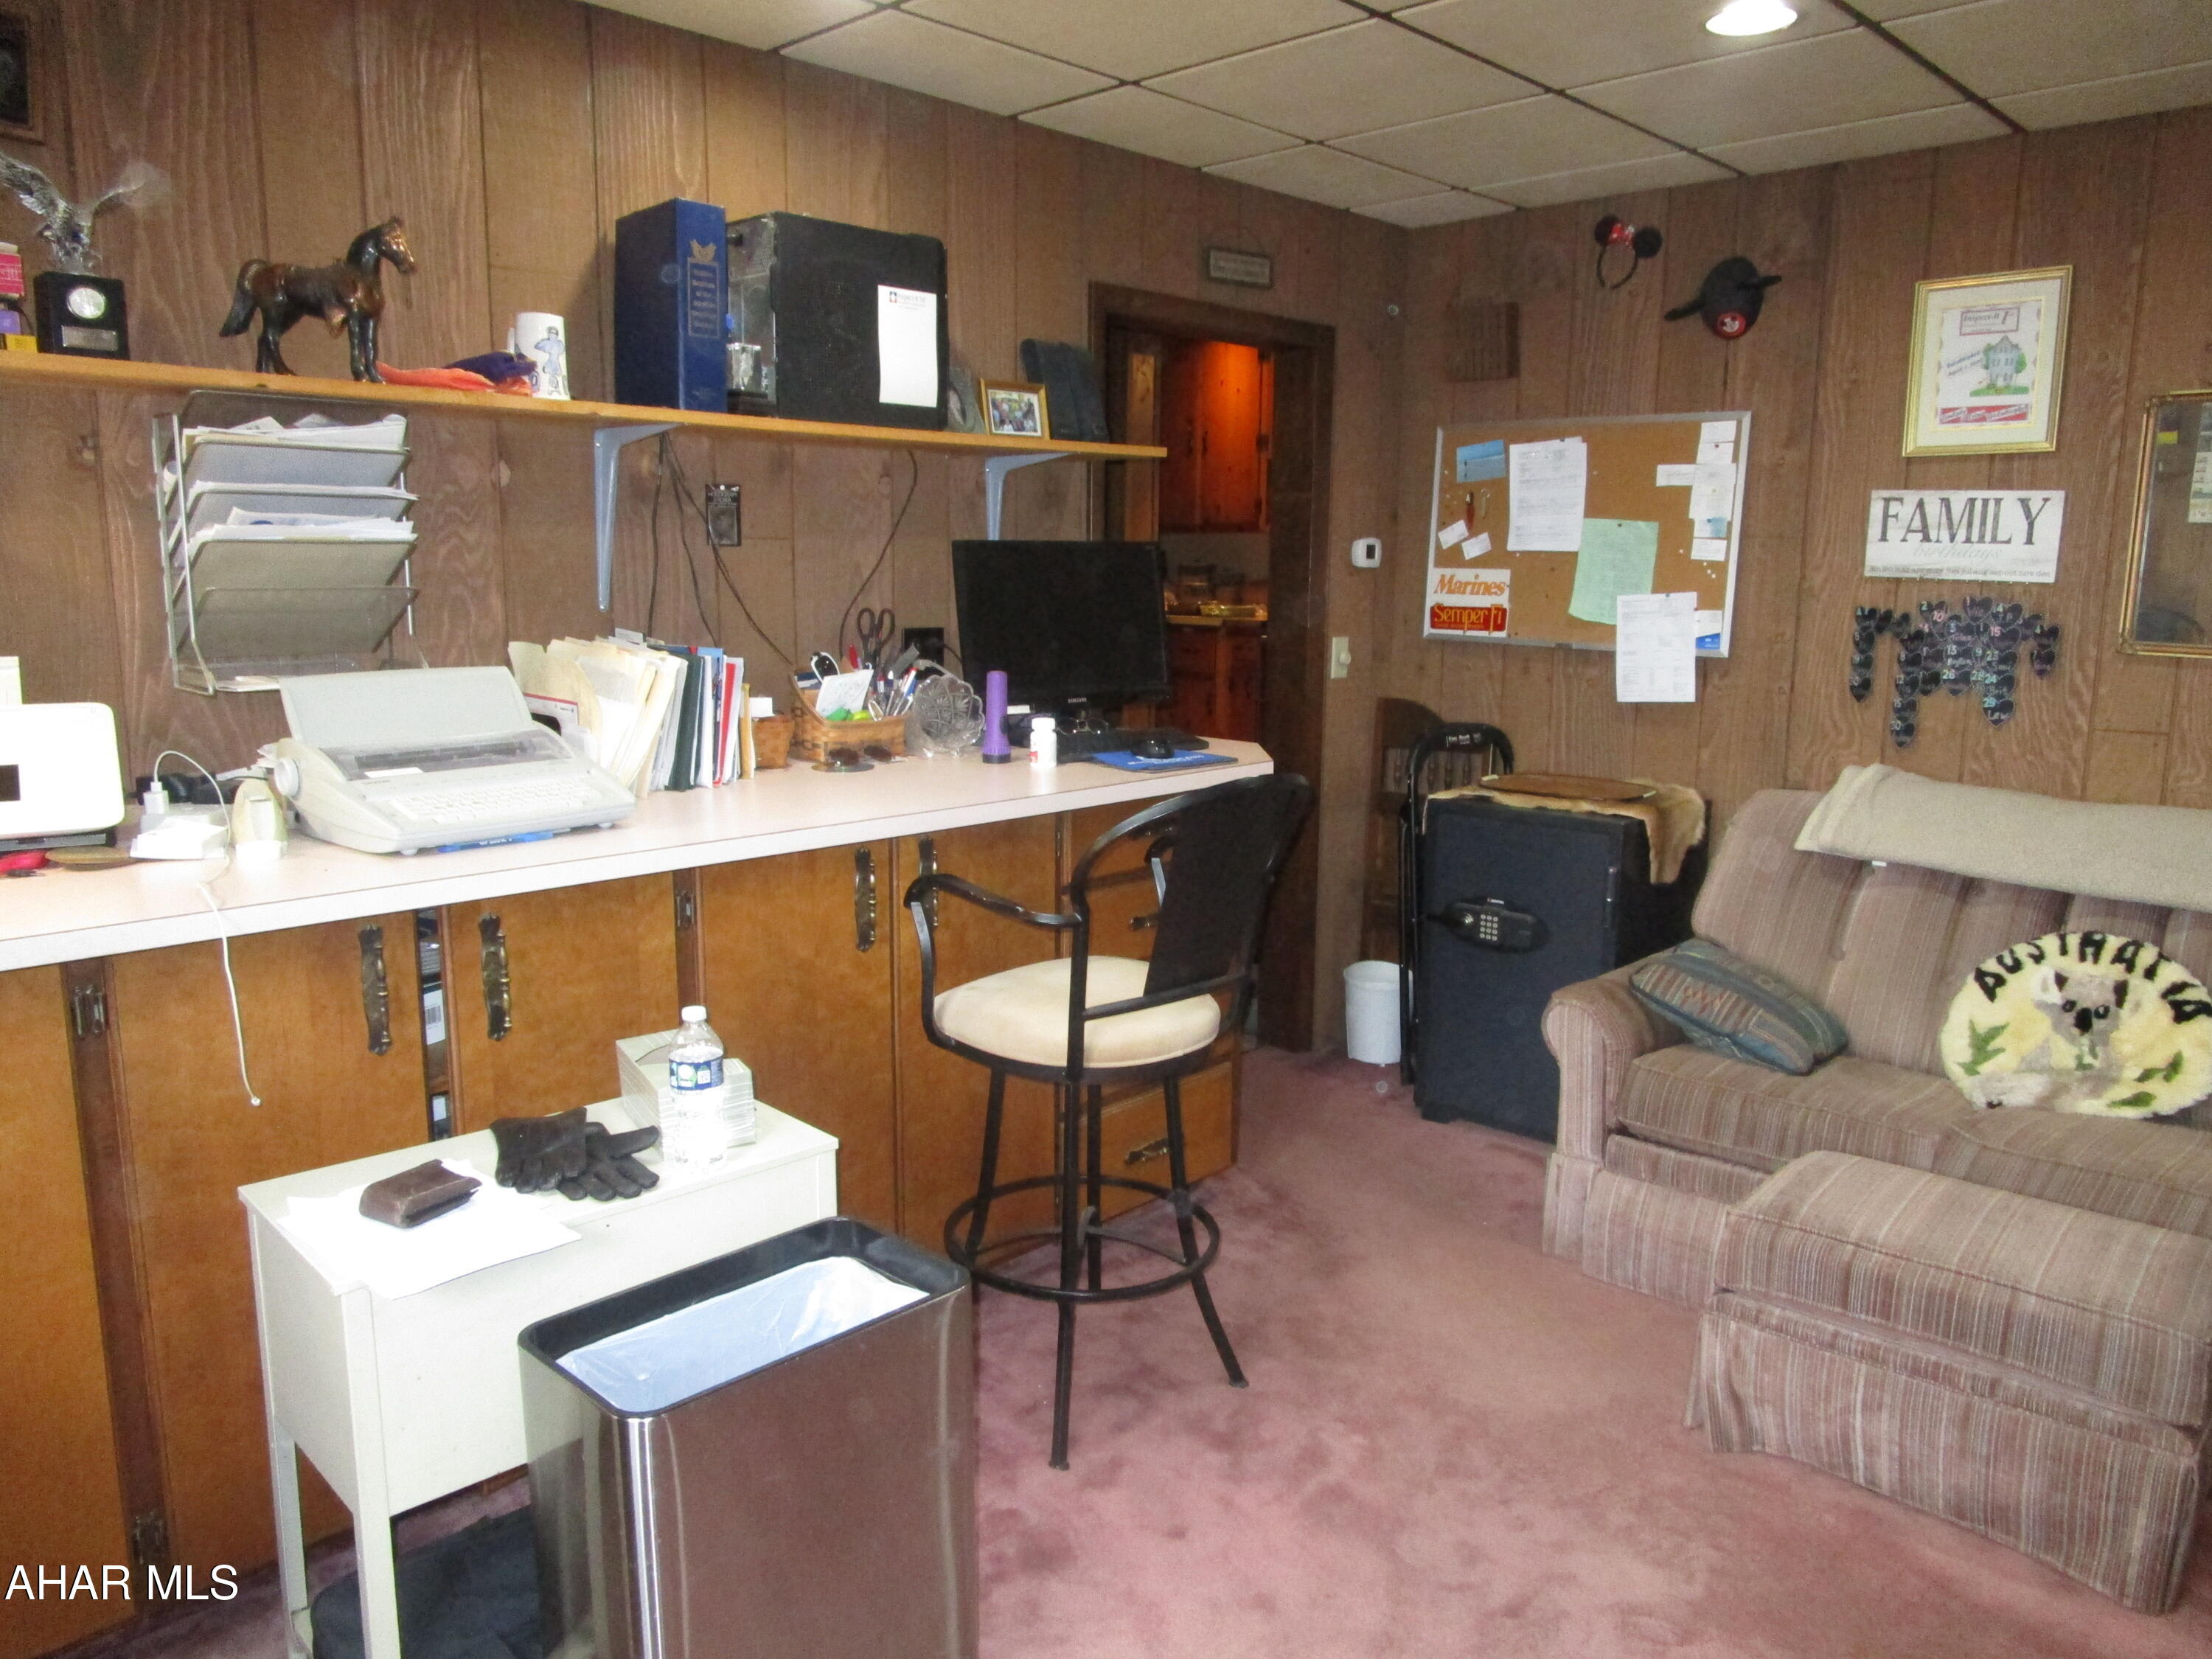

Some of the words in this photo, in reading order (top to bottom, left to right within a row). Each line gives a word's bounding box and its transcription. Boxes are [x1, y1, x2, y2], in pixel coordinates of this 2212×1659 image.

[1878, 497, 2051, 545] FAMILY
[1433, 573, 1506, 596] Marines
[1433, 602, 1488, 632] Semper
[1488, 603, 1504, 633] Fi
[1974, 931, 2212, 1024] AUSTRALIA
